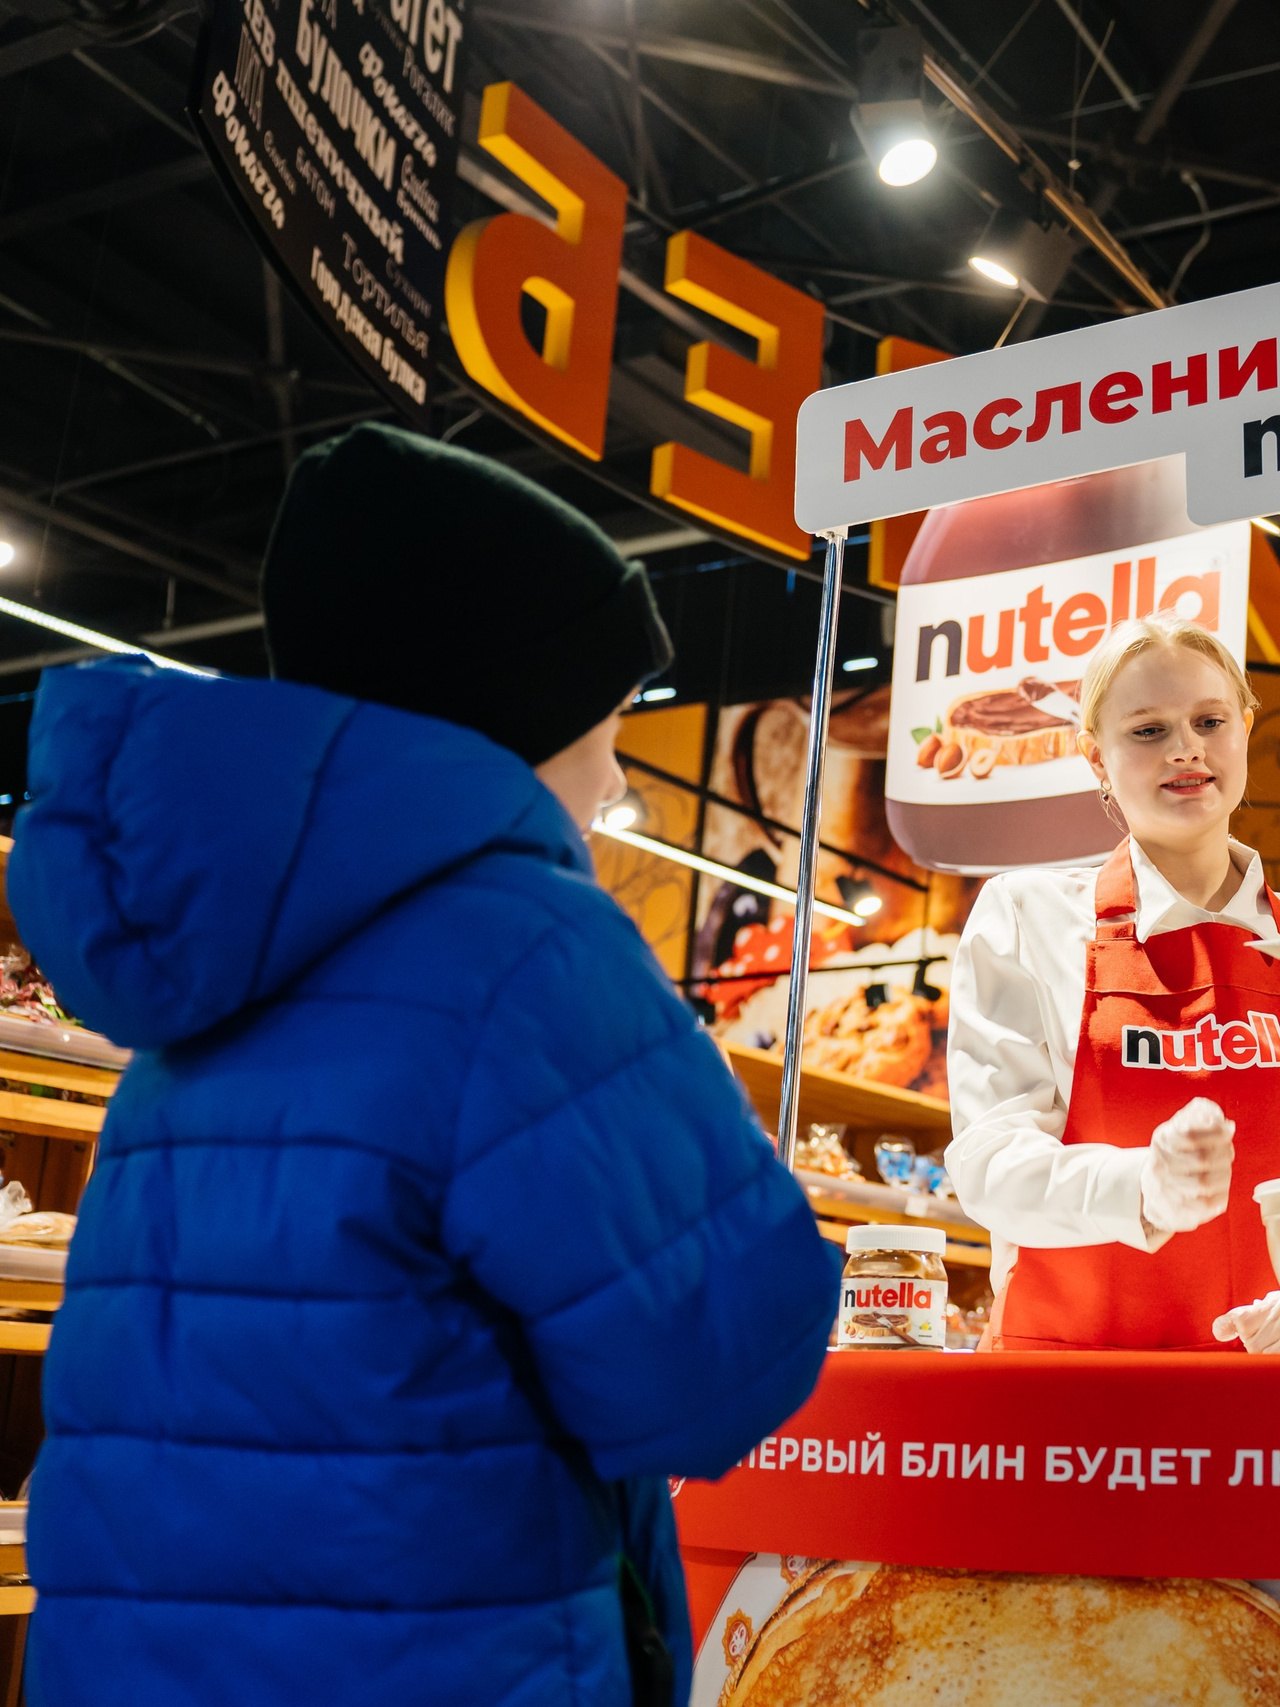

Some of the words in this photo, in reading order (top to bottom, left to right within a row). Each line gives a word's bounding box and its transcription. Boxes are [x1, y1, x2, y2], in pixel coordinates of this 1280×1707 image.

[403, 45, 455, 137] Рогалик
[915, 556, 1222, 682] nutella
[844, 1282, 931, 1309] nutella
[901, 1442, 1025, 1481] БЛИН
[1044, 1446, 1212, 1490] БУДЕТ
